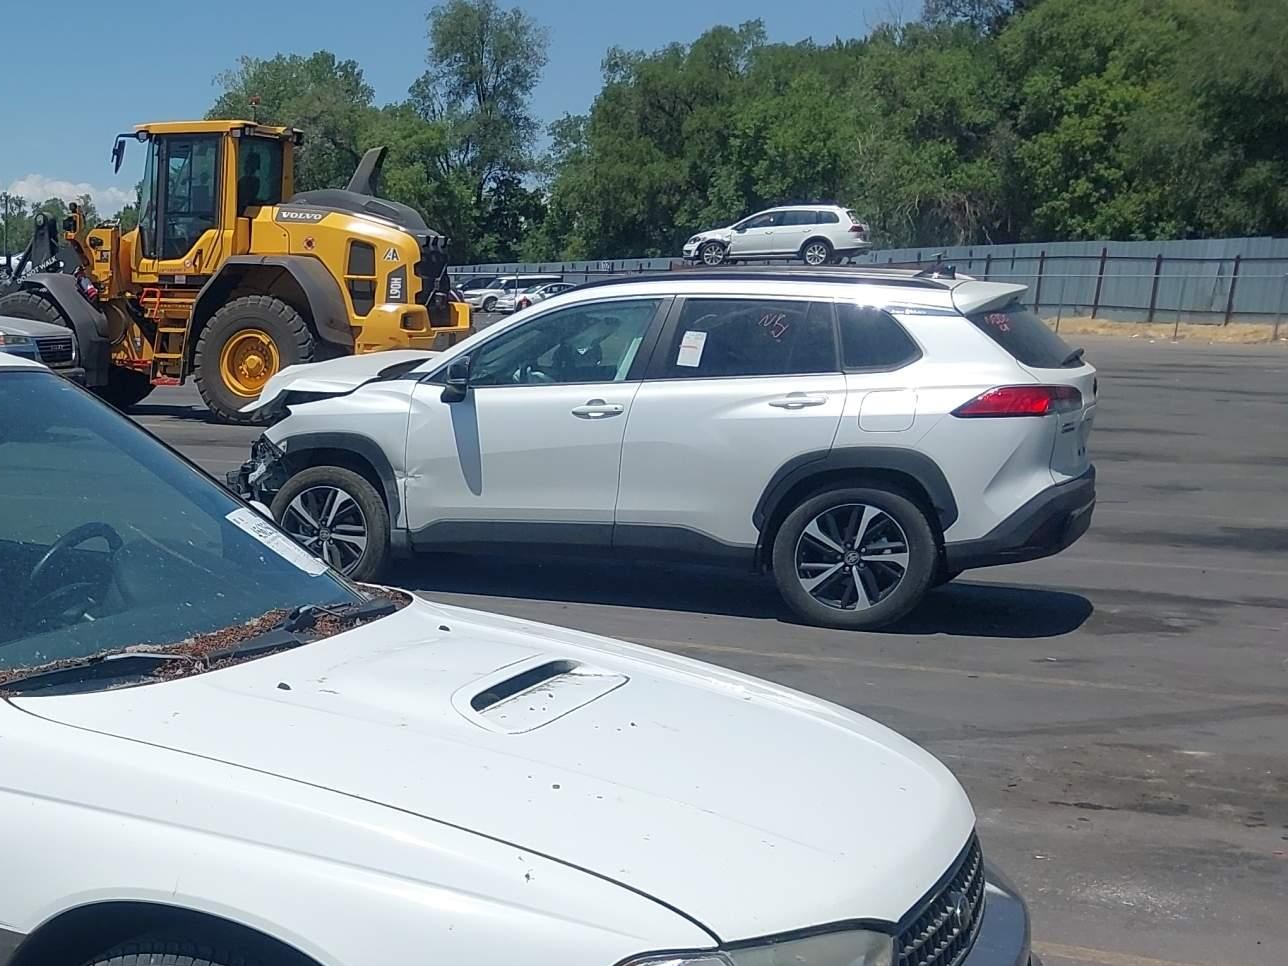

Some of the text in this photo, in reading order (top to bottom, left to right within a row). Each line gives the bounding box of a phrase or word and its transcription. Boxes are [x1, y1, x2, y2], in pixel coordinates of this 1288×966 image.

[281, 211, 322, 220] VOLVO
[38, 255, 58, 270] WALK
[389, 277, 402, 299] L90H
